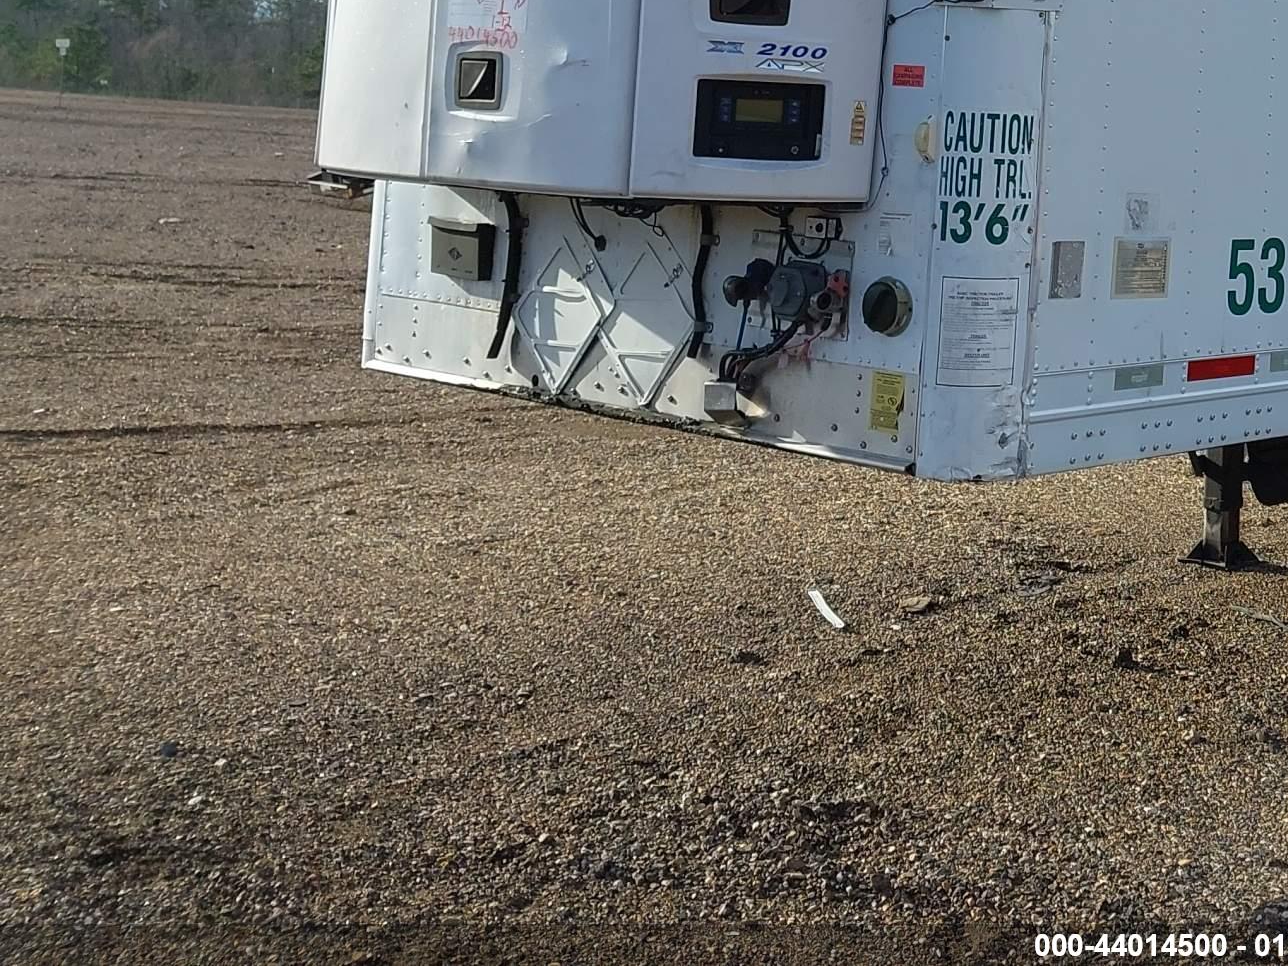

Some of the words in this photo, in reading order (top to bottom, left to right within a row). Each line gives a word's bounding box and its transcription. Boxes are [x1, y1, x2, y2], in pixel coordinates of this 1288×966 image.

[756, 43, 828, 60] 2100
[943, 110, 1034, 155] CAUTION
[938, 155, 983, 198] HIGH
[993, 158, 1032, 199] TRL.
